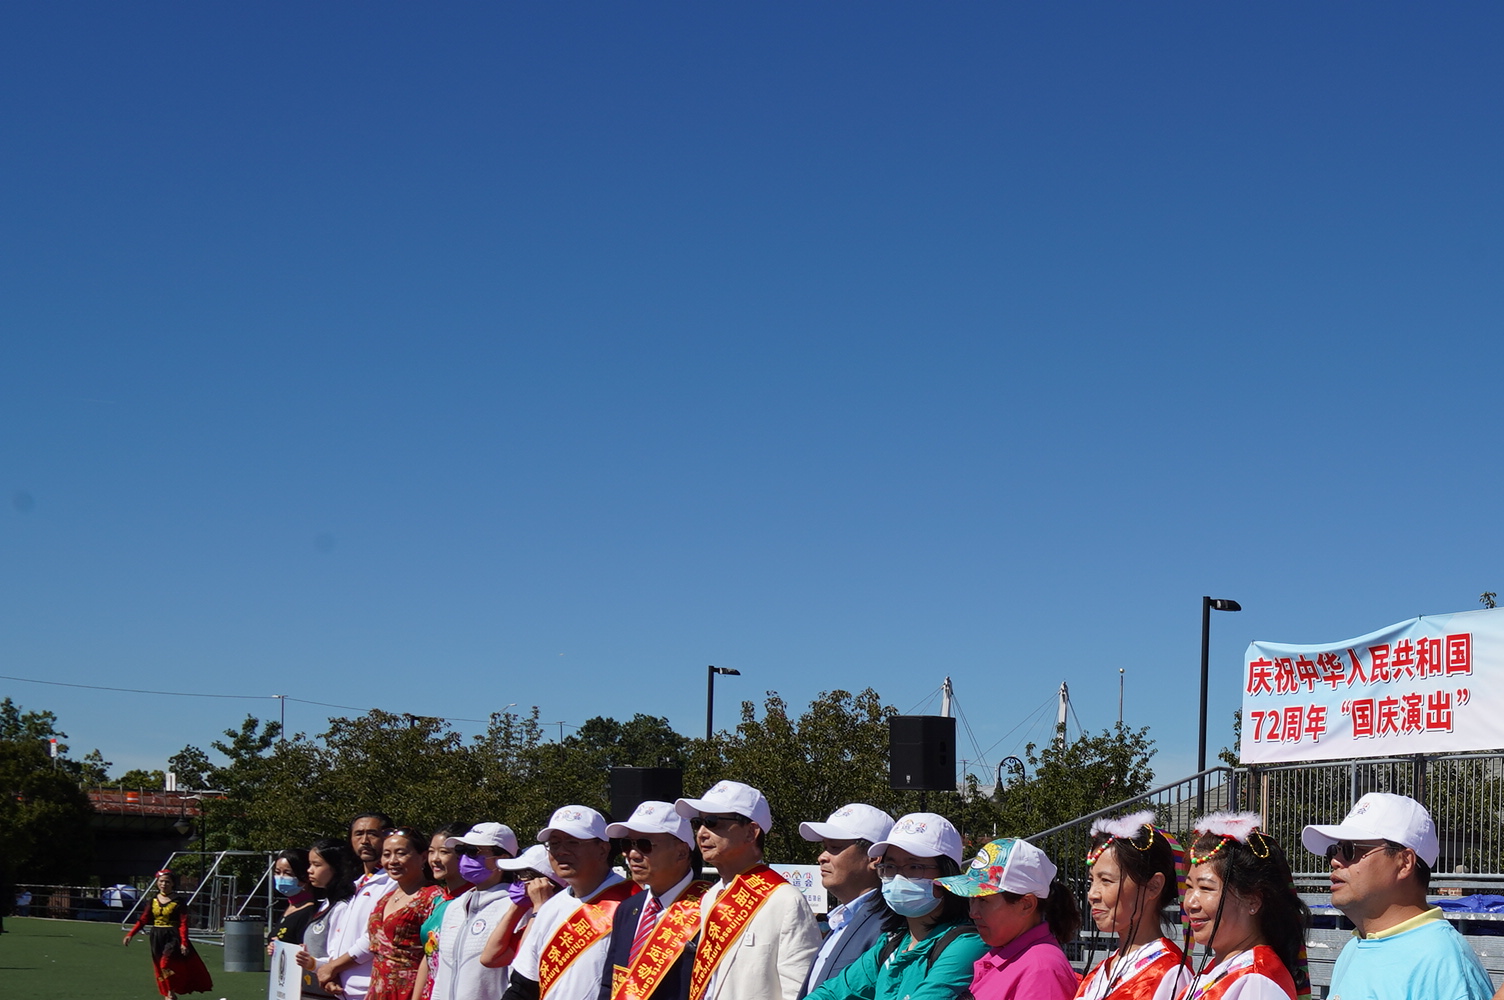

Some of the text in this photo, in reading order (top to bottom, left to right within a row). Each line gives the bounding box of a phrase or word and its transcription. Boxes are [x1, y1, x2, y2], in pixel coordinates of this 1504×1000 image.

[1246, 632, 1473, 695] 庆祝中华人民共和国
[720, 909, 749, 943] Chinese
[697, 941, 723, 984] American
